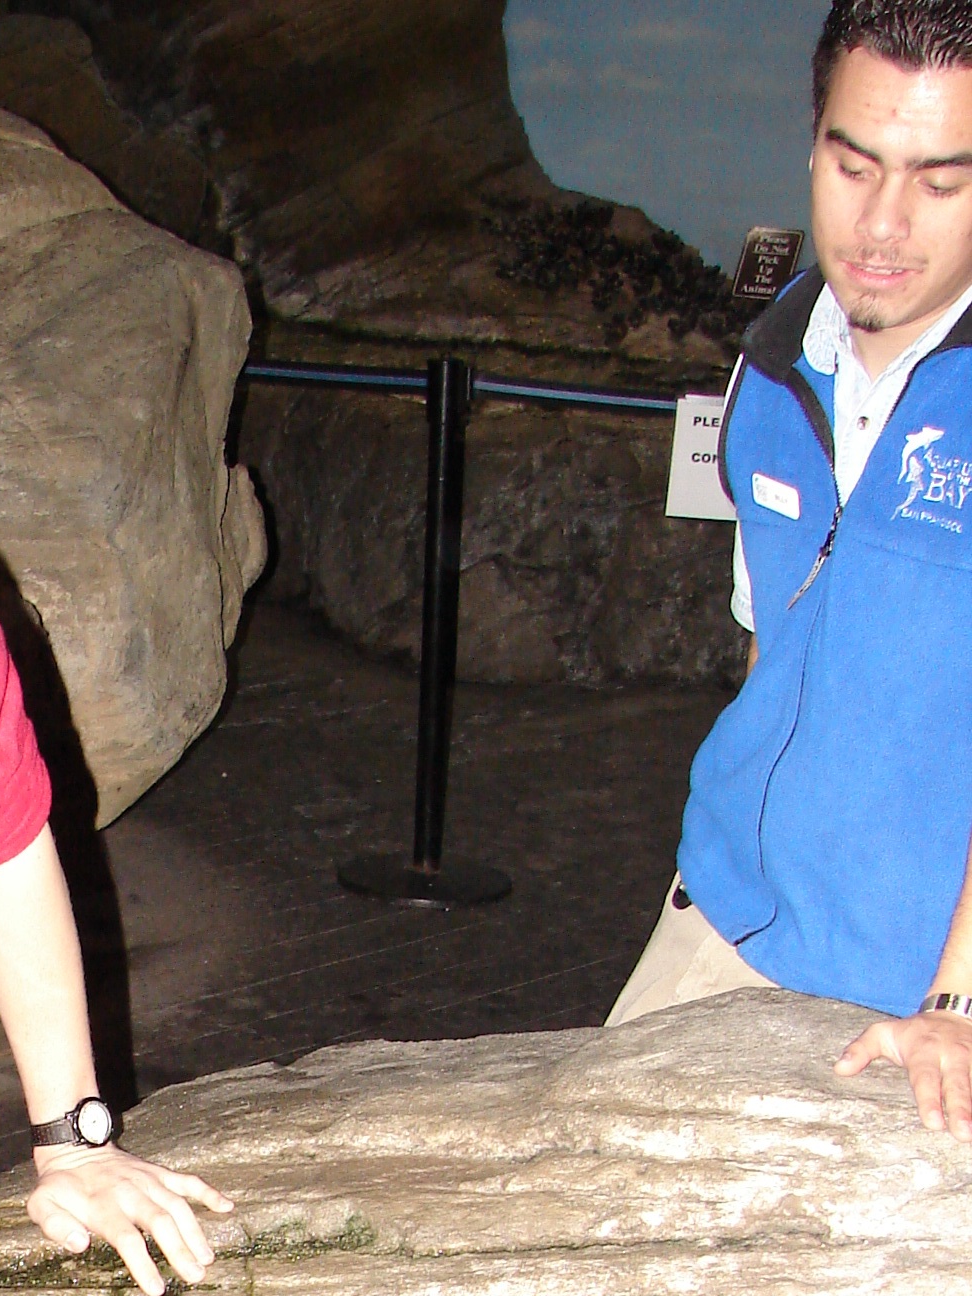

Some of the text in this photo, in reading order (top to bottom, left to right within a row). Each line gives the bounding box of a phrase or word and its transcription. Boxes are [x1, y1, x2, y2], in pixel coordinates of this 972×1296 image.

[754, 243, 789, 254] Do Not
[758, 255, 778, 265] Pick
[759, 264, 774, 275] Up
[755, 274, 773, 284] The
[923, 471, 972, 509] BAY
